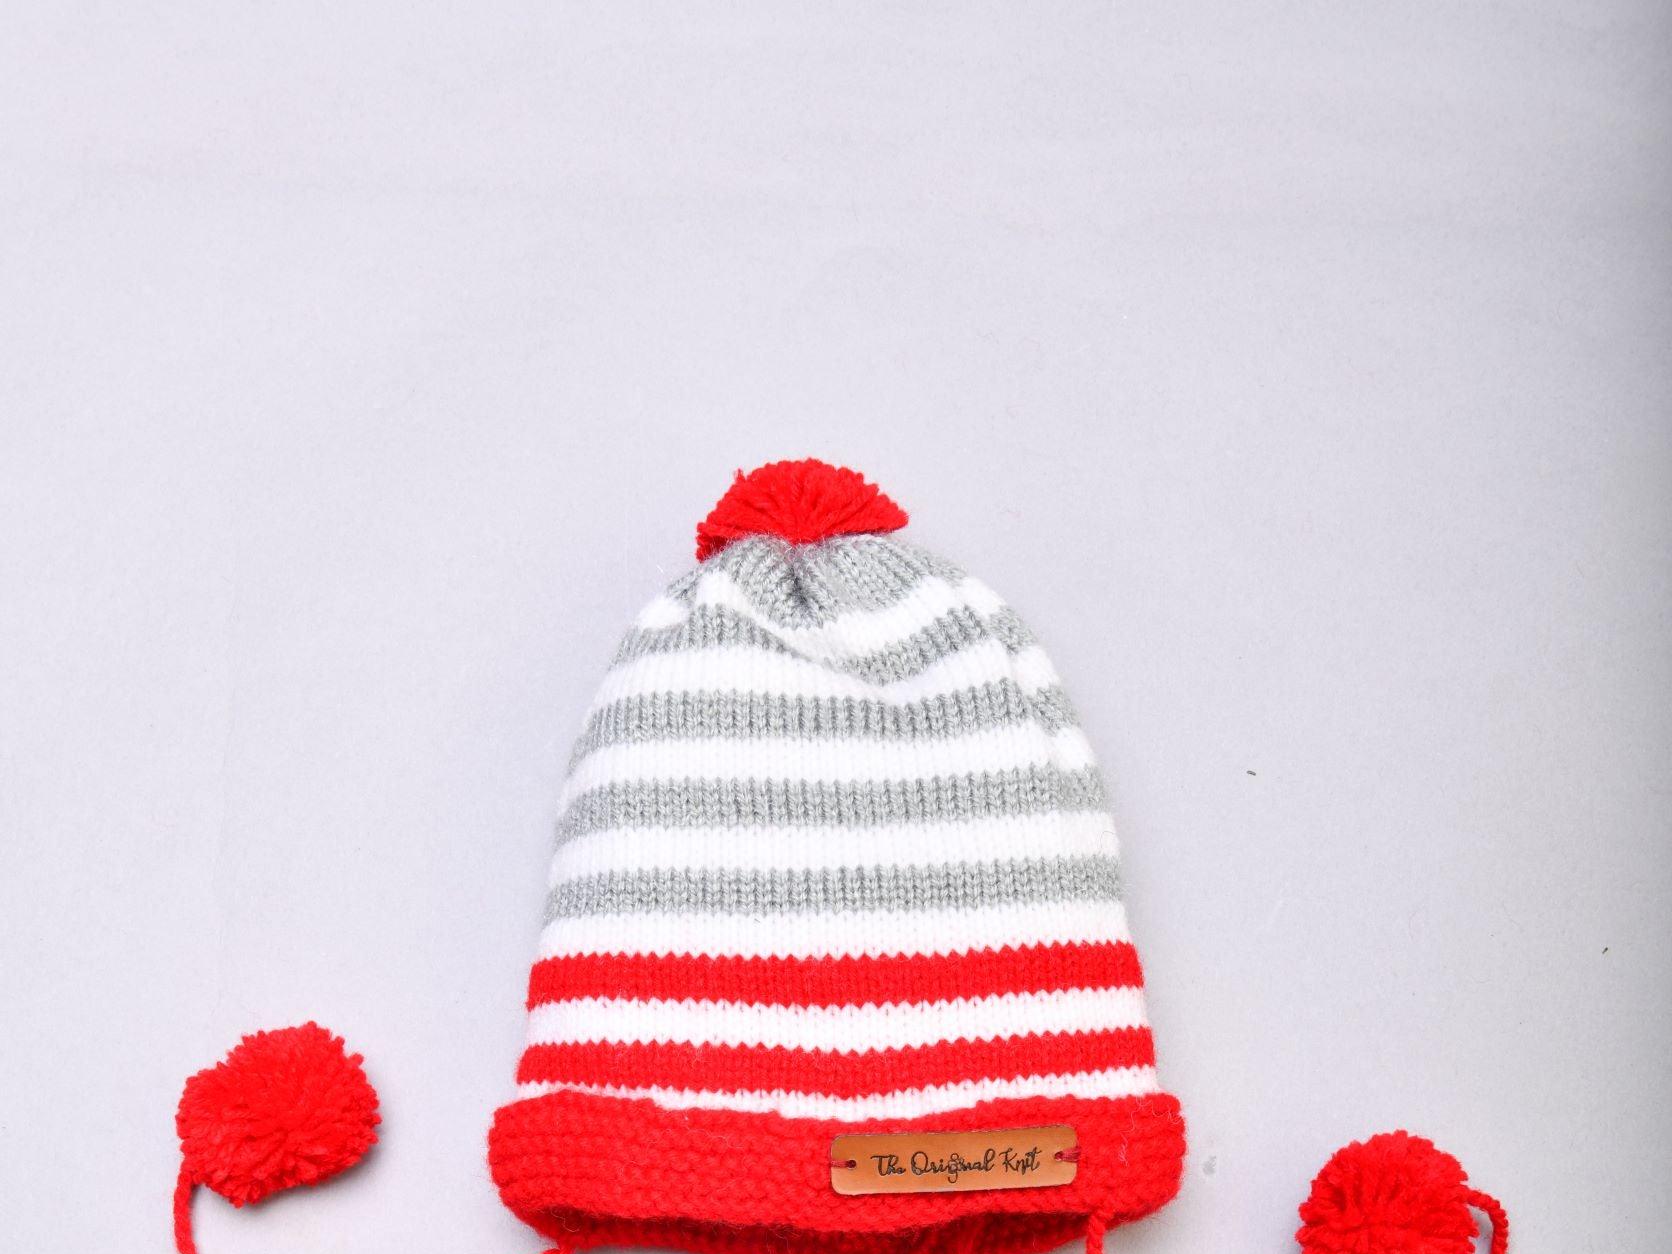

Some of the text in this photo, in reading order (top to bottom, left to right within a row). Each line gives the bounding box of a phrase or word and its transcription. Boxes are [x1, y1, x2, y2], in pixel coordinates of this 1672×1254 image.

[870, 1146, 1042, 1184] The Original Knit
